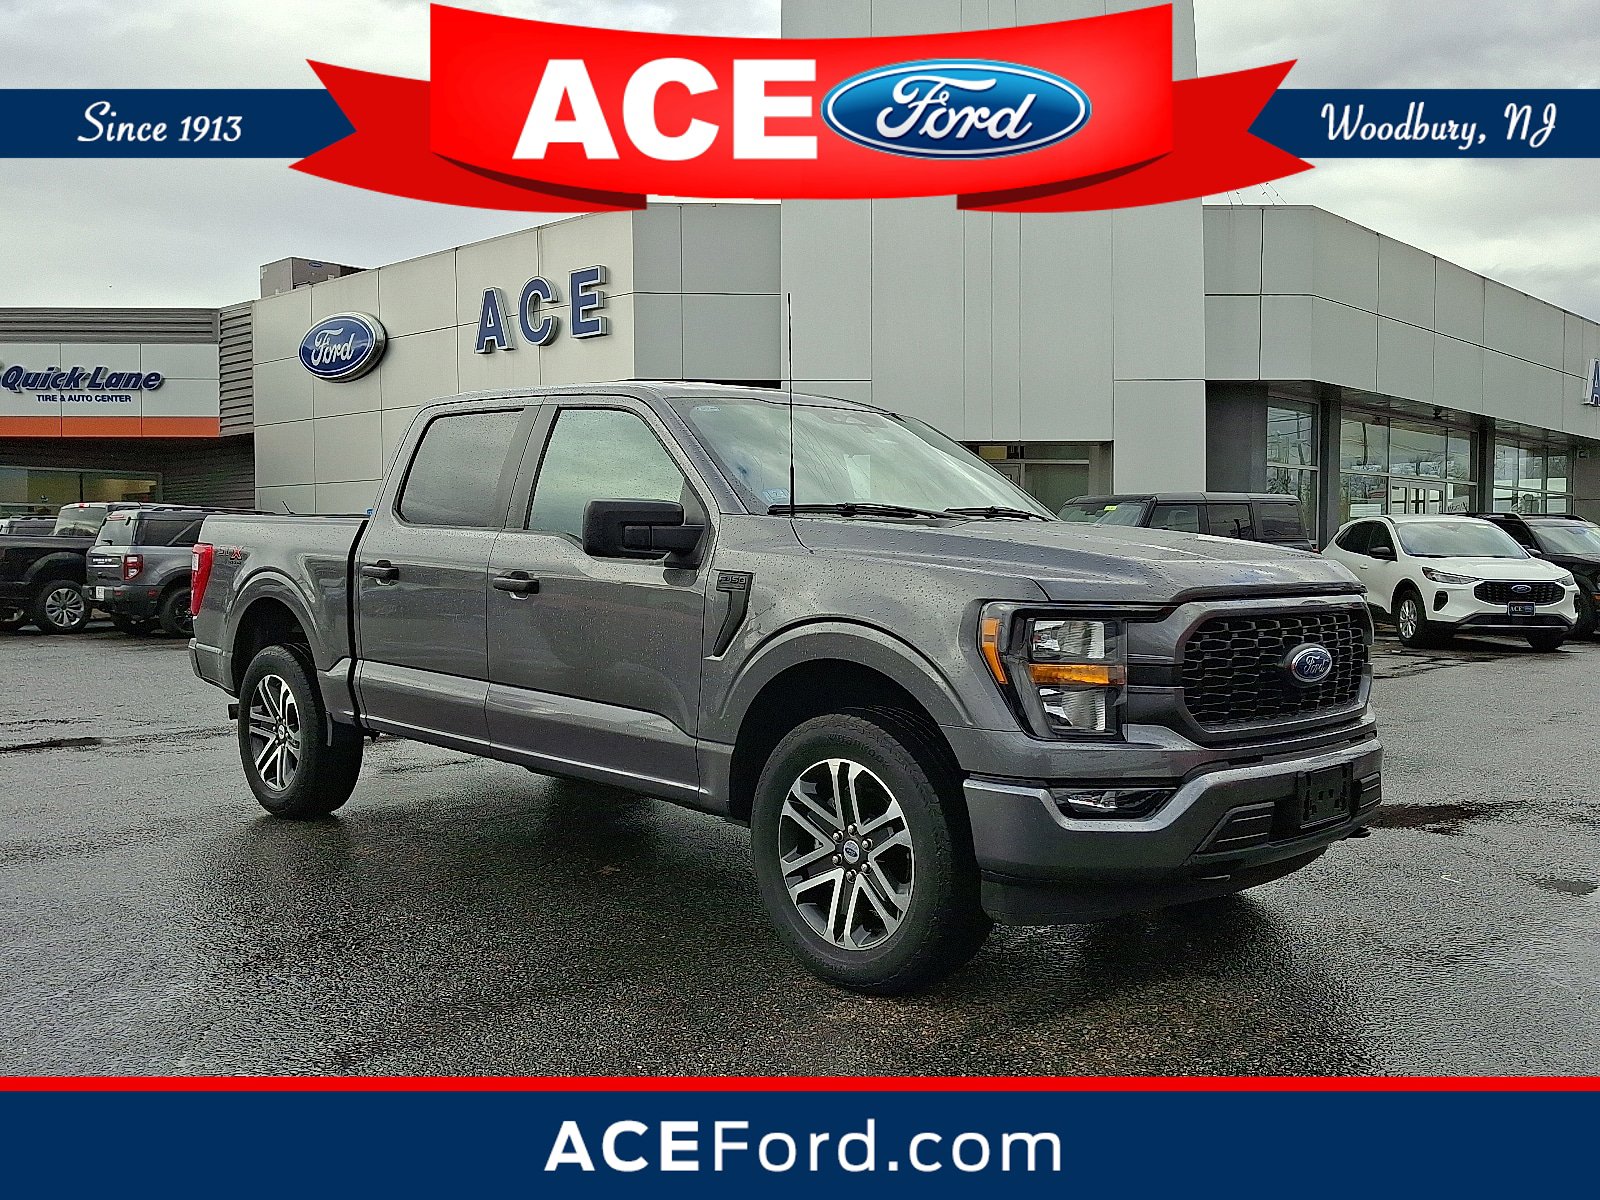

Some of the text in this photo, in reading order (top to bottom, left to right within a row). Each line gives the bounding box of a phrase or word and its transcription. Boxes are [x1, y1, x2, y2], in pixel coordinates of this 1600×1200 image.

[475, 265, 606, 354] ACE
[310, 326, 355, 367] Ford
[1, 365, 162, 392] Quick Lane
[36, 394, 58, 403] TIRE
[67, 394, 93, 403] AUTO
[94, 394, 132, 403] CENTER
[1303, 655, 1329, 675] Ford
